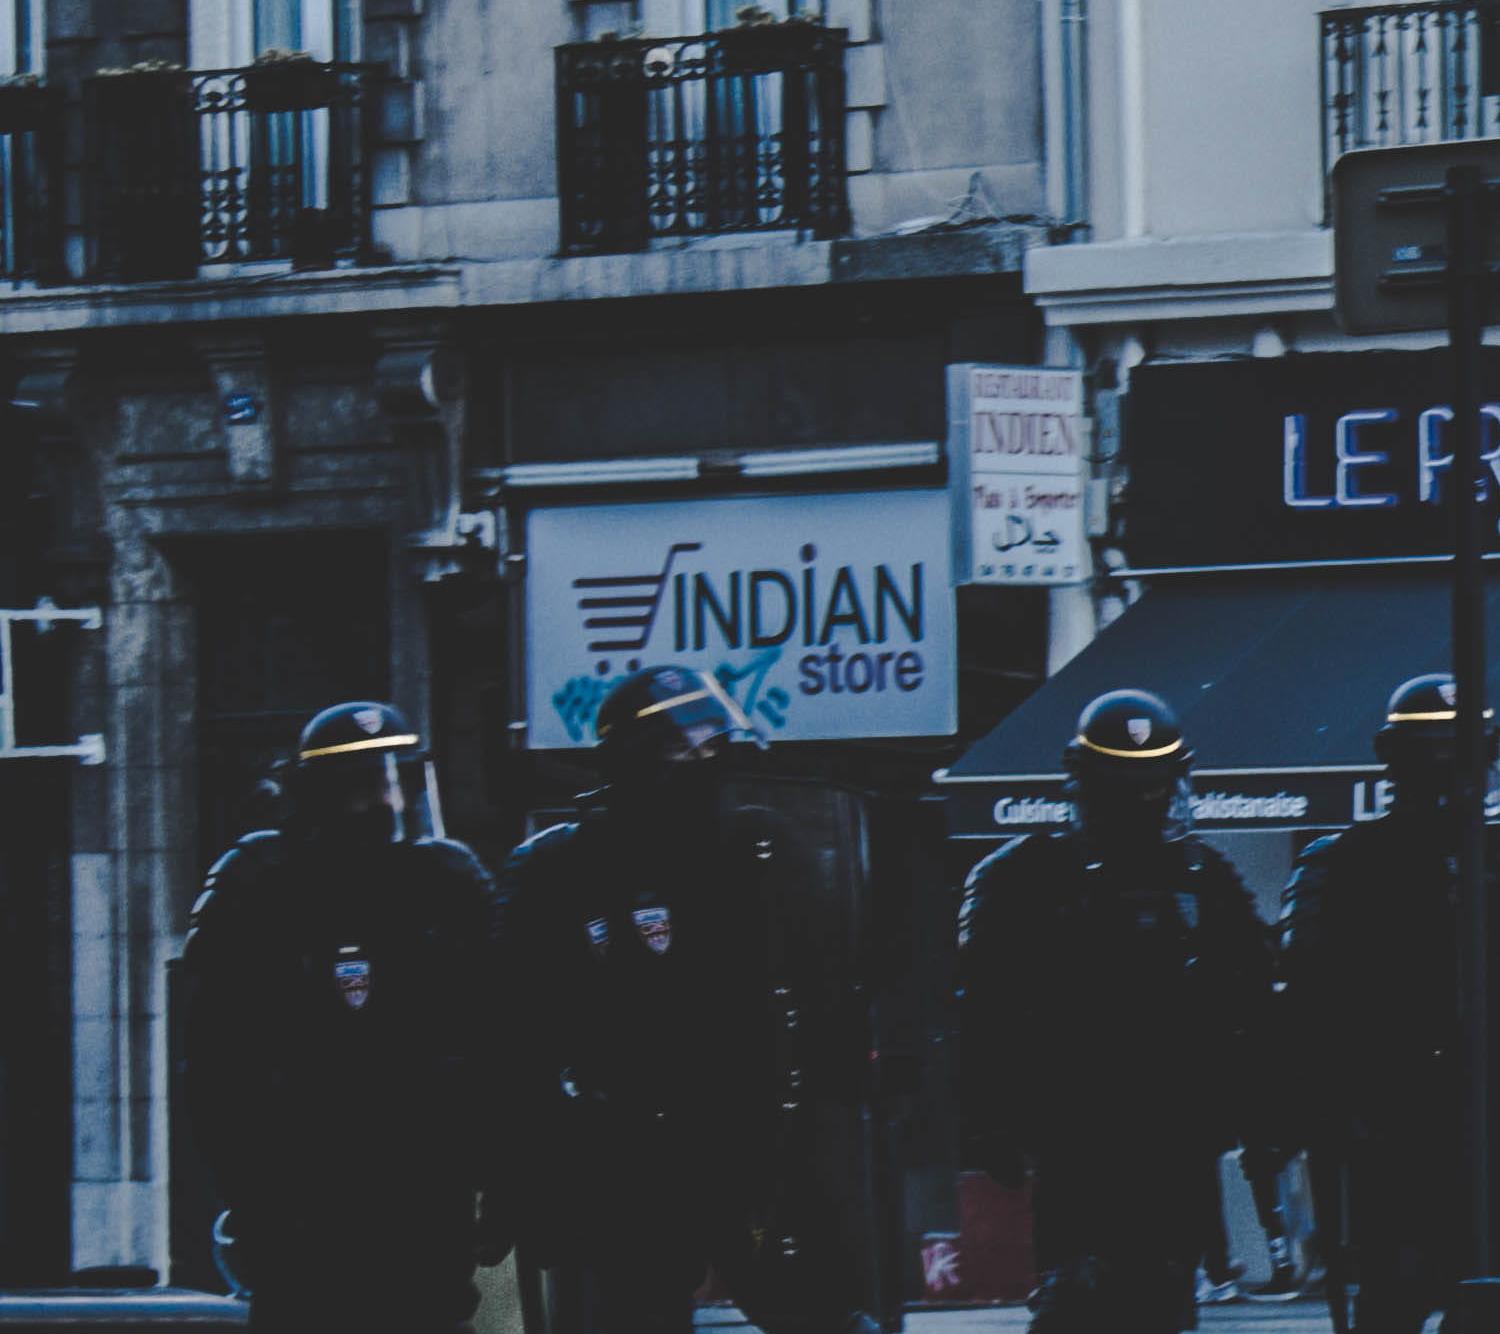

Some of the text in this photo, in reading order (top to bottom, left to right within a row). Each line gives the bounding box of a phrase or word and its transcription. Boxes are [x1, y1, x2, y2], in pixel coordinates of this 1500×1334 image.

[975, 372, 1074, 401] RESTAURANT
[973, 410, 1078, 457] INDIEN
[1283, 408, 1398, 509] LE
[799, 643, 925, 694] store
[993, 796, 1072, 825] Cuisine
[1352, 779, 1398, 821] LE
